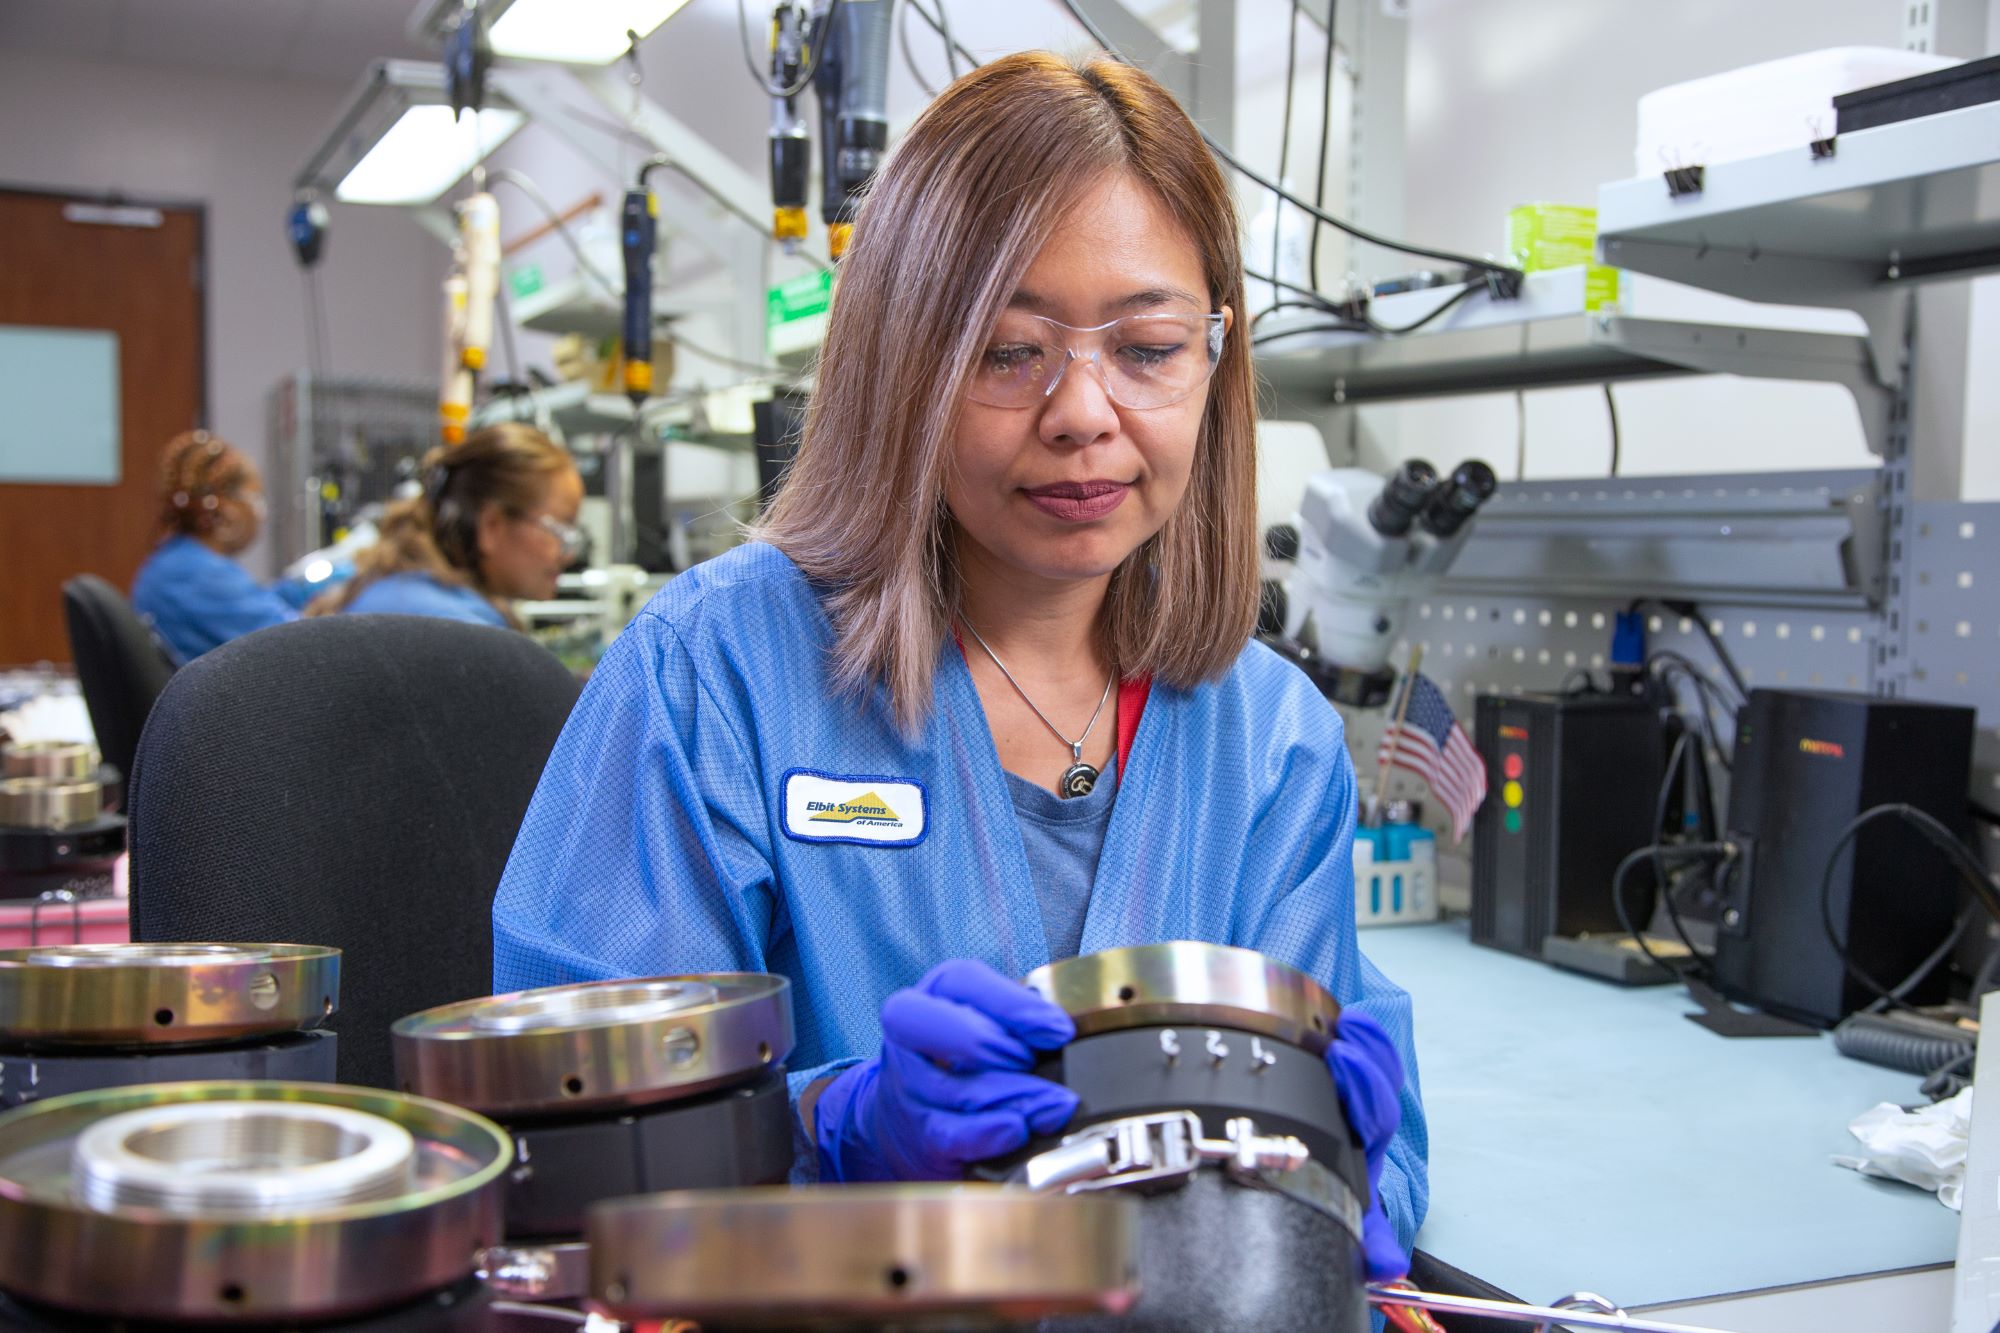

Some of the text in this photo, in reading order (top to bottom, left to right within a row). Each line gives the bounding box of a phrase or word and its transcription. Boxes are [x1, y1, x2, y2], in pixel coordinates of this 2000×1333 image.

[806, 801, 886, 815] Elbit Systems
[866, 819, 903, 828] America
